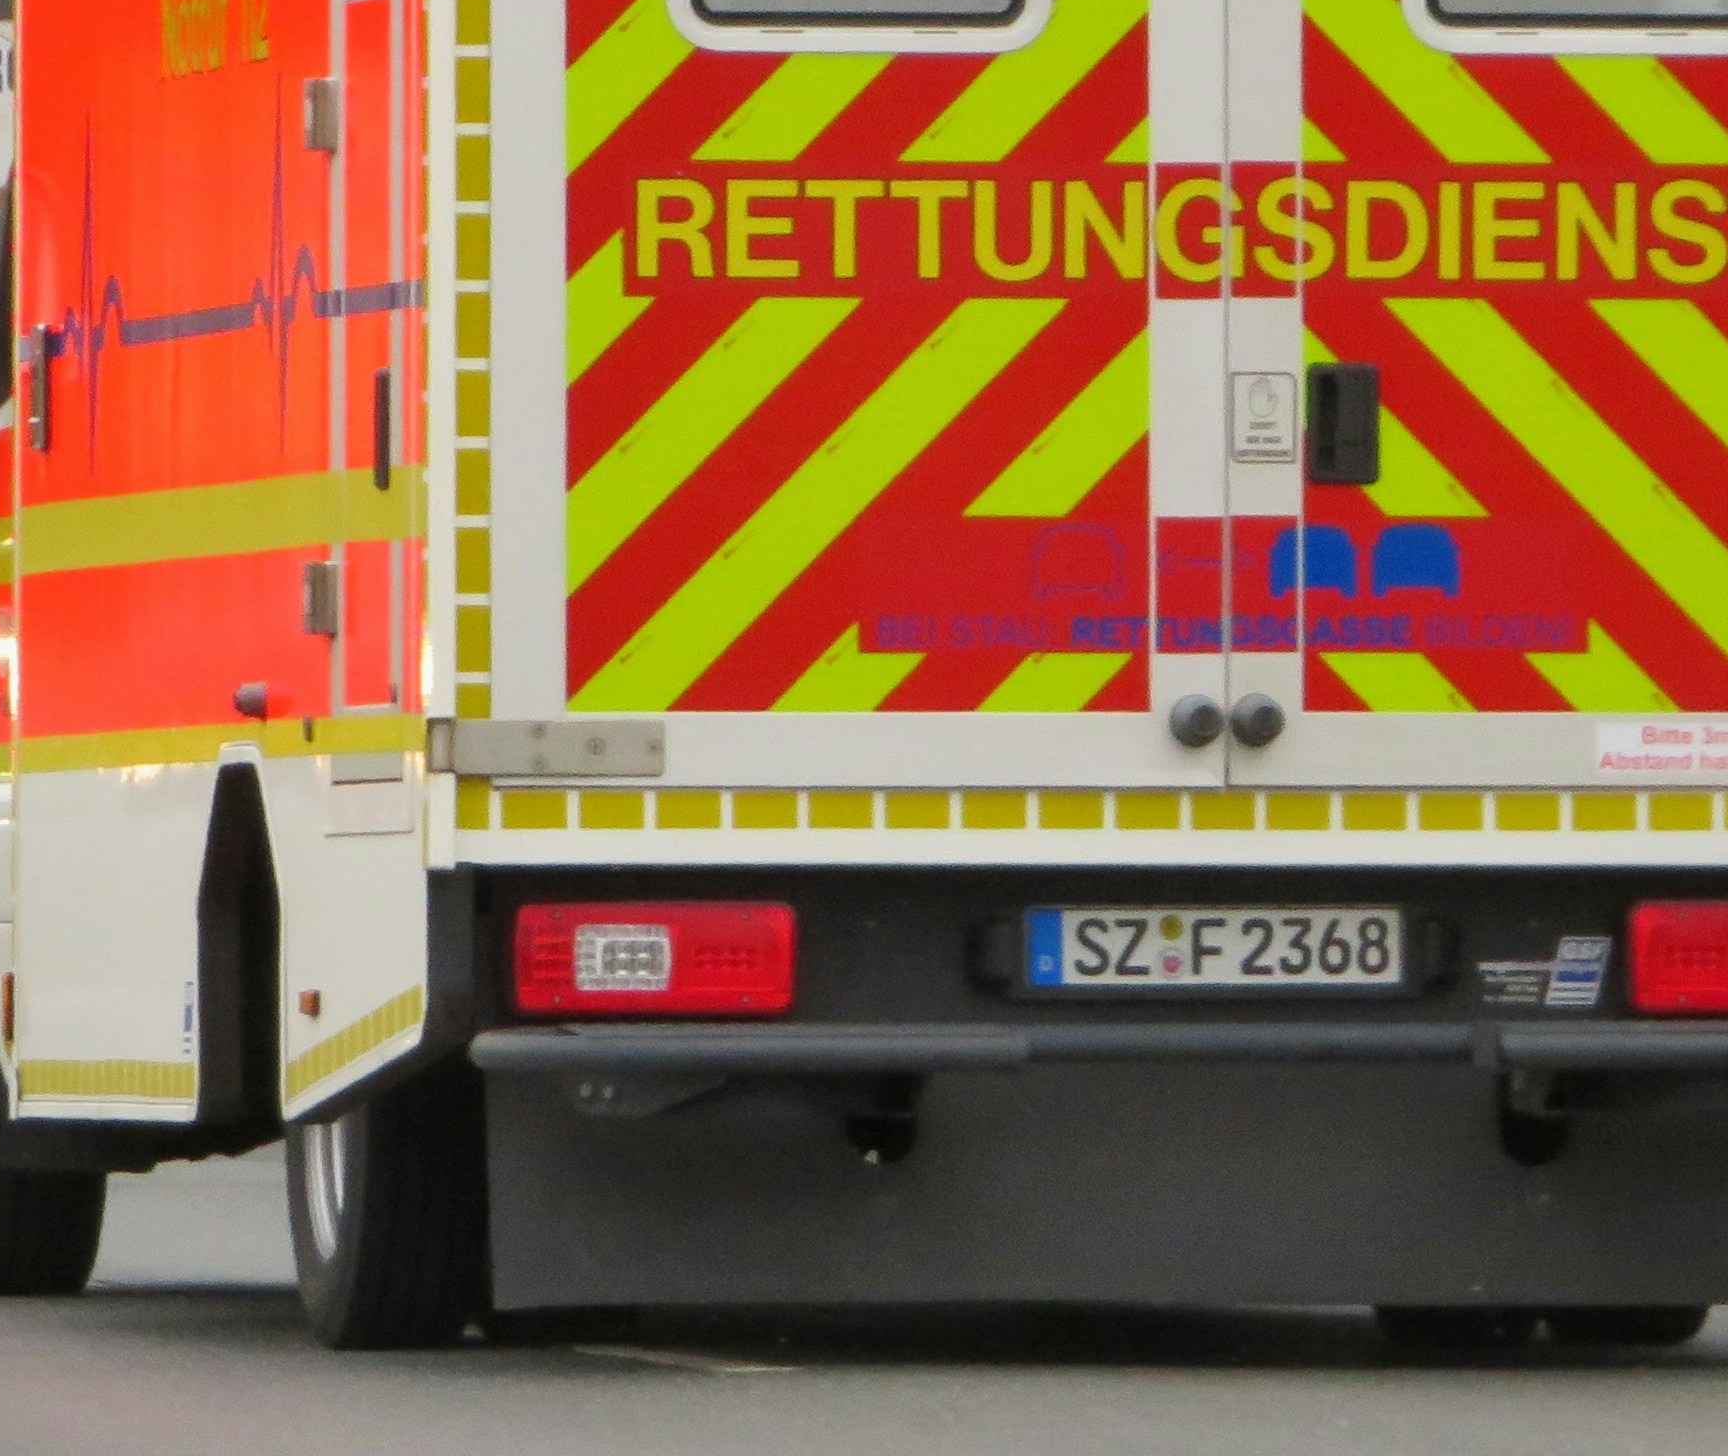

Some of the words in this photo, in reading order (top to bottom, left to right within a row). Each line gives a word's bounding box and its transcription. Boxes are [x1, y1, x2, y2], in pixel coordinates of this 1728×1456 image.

[1068, 614, 1414, 649] RETTUNGSGASSE
[1640, 725, 1693, 745] Bitte
[1598, 751, 1693, 771] Abstand
[1074, 917, 1150, 977] SZ
